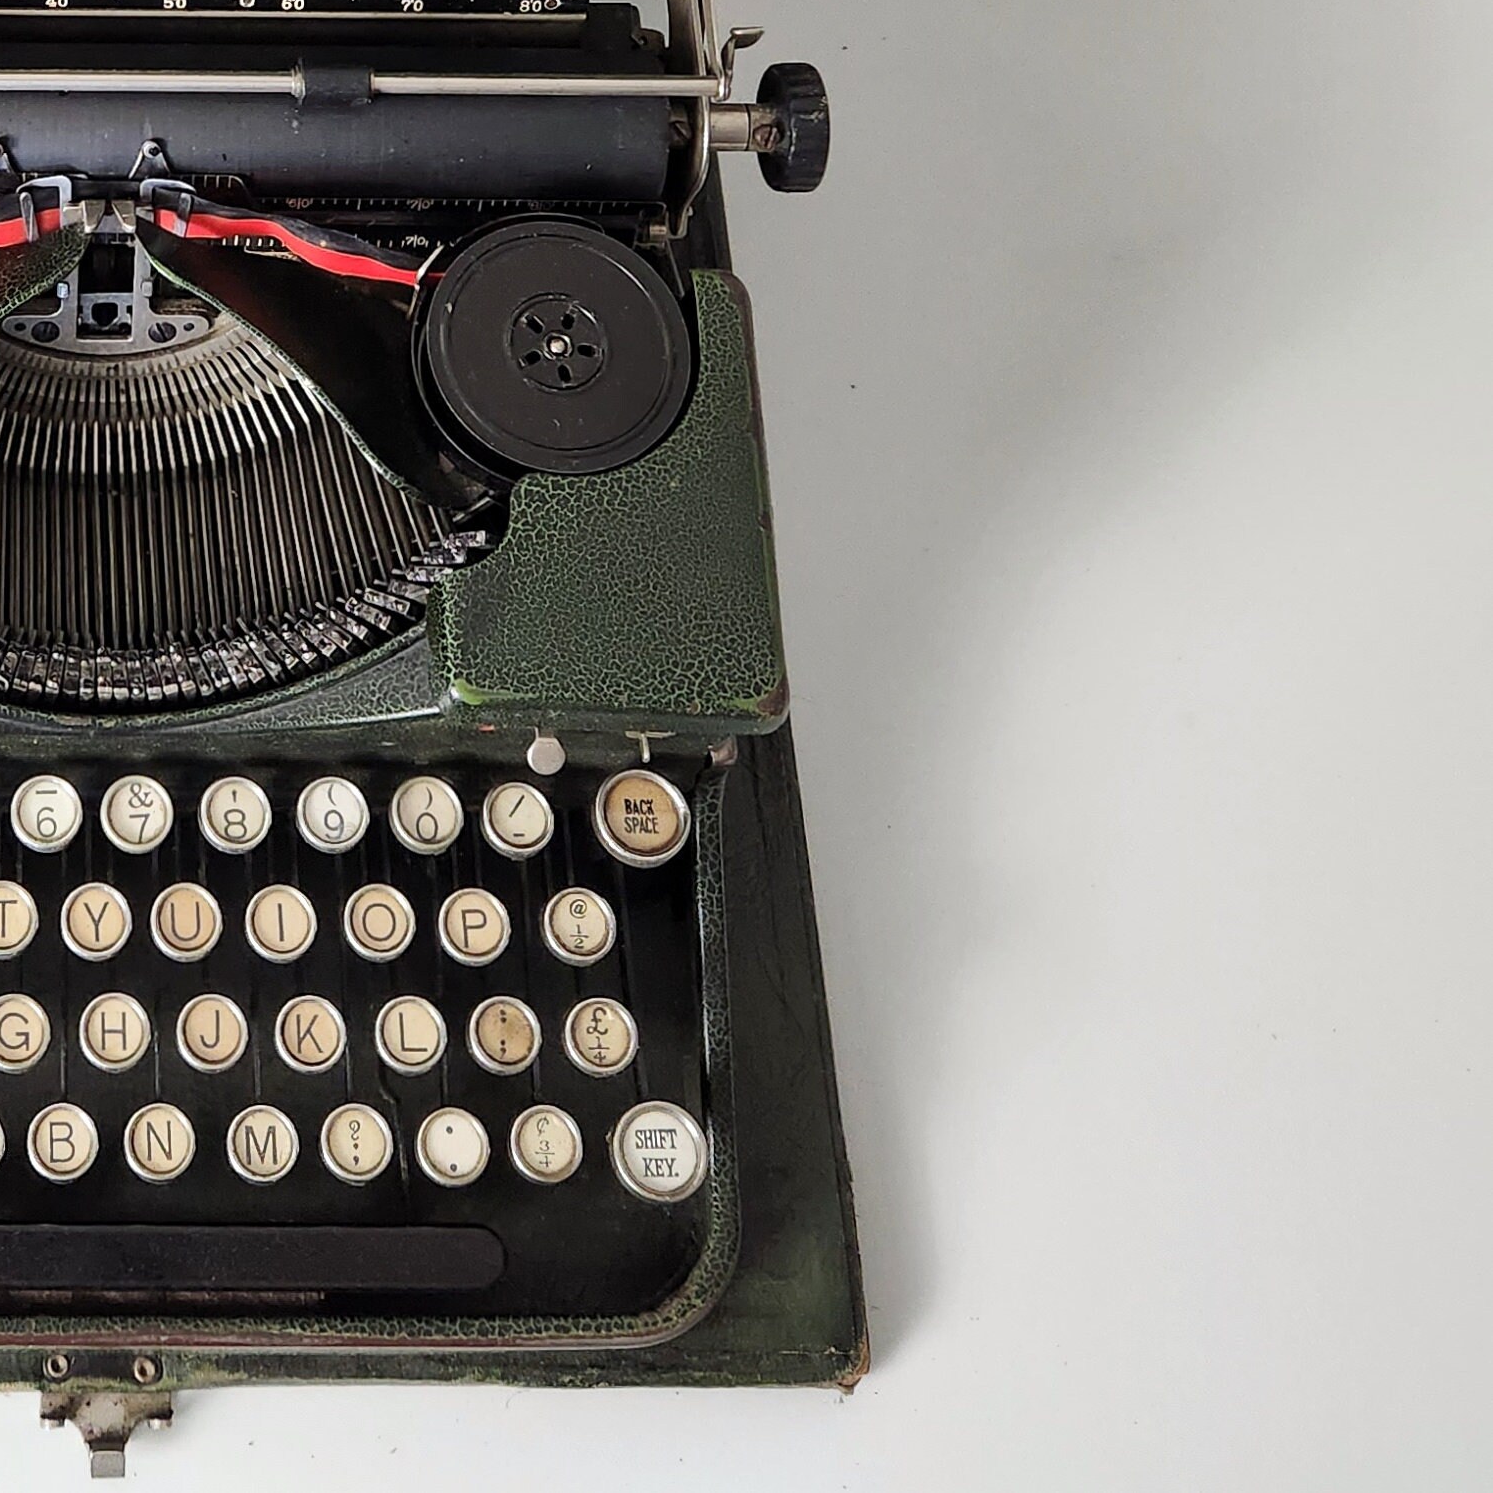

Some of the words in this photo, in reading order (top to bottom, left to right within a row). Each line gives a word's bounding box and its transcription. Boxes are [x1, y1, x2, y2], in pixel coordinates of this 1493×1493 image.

[519, 0, 542, 13] 80
[410, 199, 432, 211] 70
[405, 236, 426, 249] 70
[128, 782, 154, 808] &
[624, 798, 655, 816] BACK
[36, 806, 57, 838] 6
[128, 813, 151, 843] 7
[223, 808, 248, 840] 8
[323, 811, 346, 841] 9
[415, 812, 439, 842] 0
[624, 815, 660, 835] SPACE
[82, 901, 110, 942] Y
[169, 901, 201, 942] U
[277, 902, 285, 942] I
[361, 902, 397, 942] O
[569, 898, 588, 919] @
[460, 908, 488, 949] P
[100, 1010, 127, 1051] H
[199, 1009, 220, 1049] J
[296, 1012, 323, 1055] K
[398, 1012, 428, 1052] L
[586, 1007, 608, 1036] £
[49, 1121, 76, 1164] B
[146, 1120, 173, 1162] N
[244, 1125, 278, 1166] M
[634, 1128, 678, 1150] SHIFT
